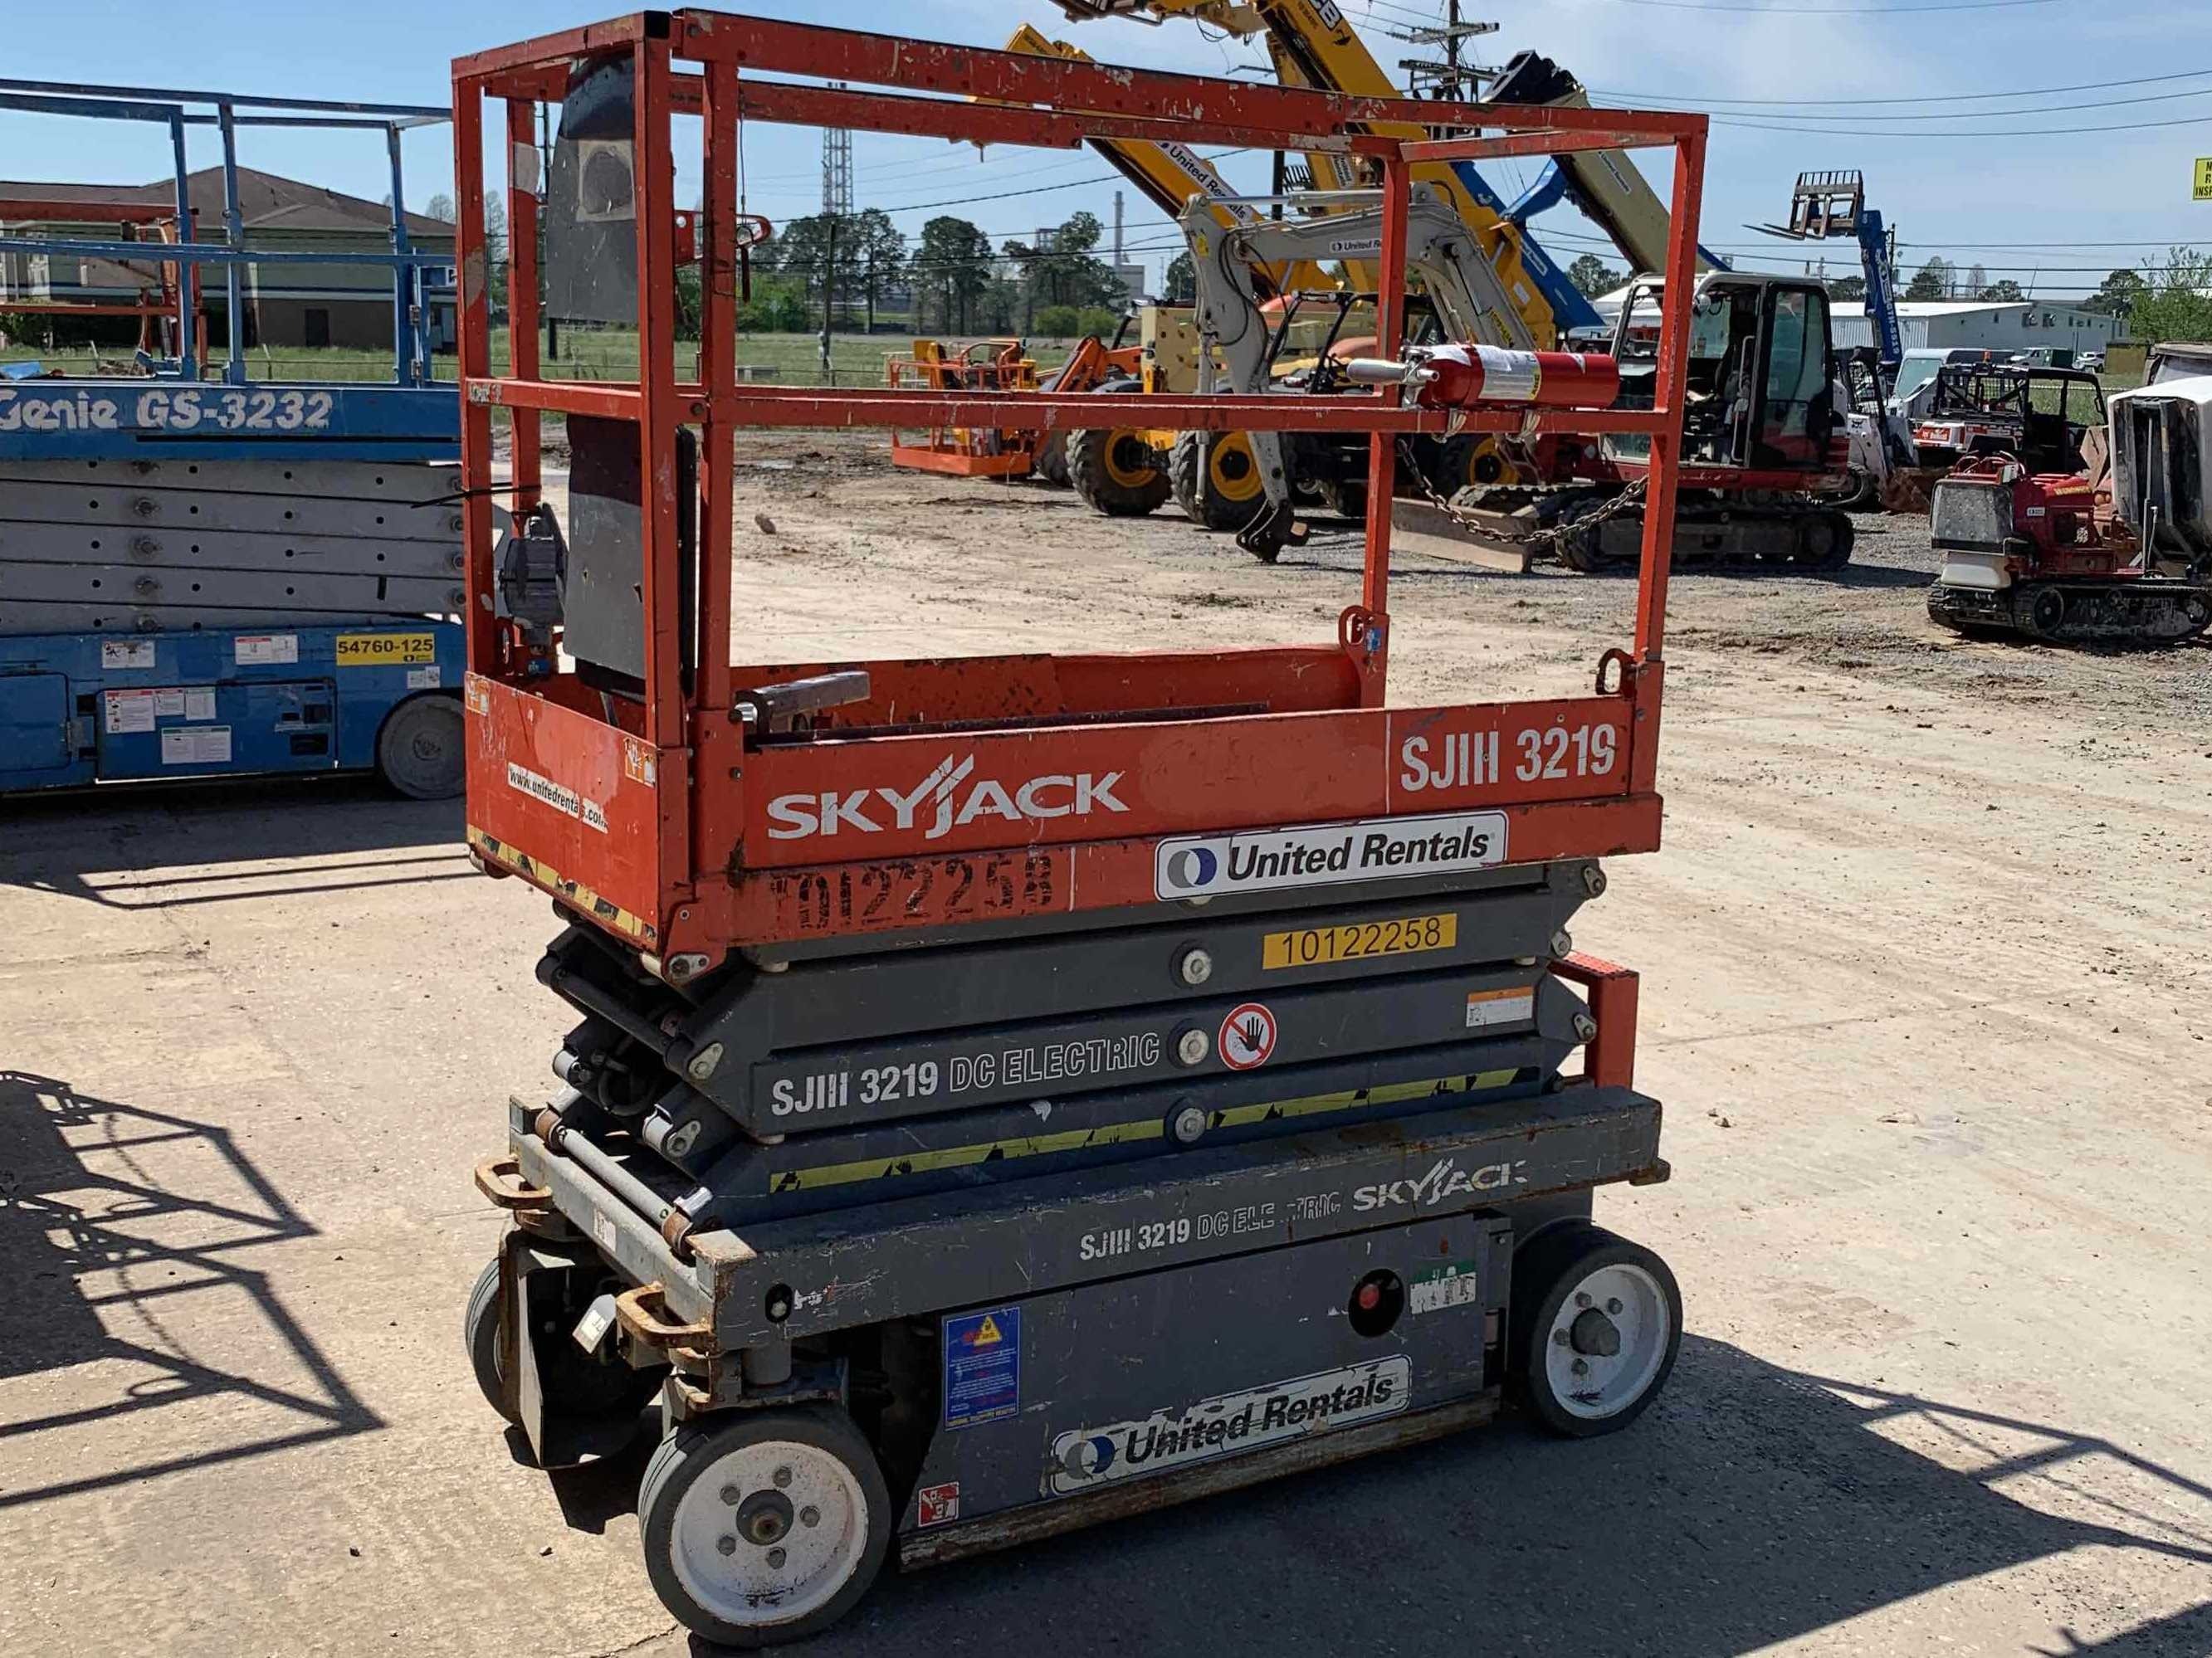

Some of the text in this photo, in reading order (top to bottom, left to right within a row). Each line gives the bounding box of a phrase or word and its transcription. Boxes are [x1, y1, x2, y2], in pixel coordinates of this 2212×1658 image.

[1169, 145, 1209, 184] United
[0, 388, 334, 431] Genie GS-3232
[337, 637, 434, 655] 54760-125
[1515, 724, 1617, 782] 3219
[509, 768, 609, 829] www.unitedrentas.co
[767, 753, 1130, 840] SKYJACK
[1228, 826, 1490, 880] United Rentals
[1282, 916, 1442, 965] 10122258
[771, 1032, 1160, 1116] SJIII 3219 DC ELECTRIC
[1137, 1217, 1191, 1251] 3219
[1196, 1210, 1229, 1241] DC
[1233, 1191, 1341, 1234] ELETRIC
[1126, 1373, 1394, 1465] United Rentals
